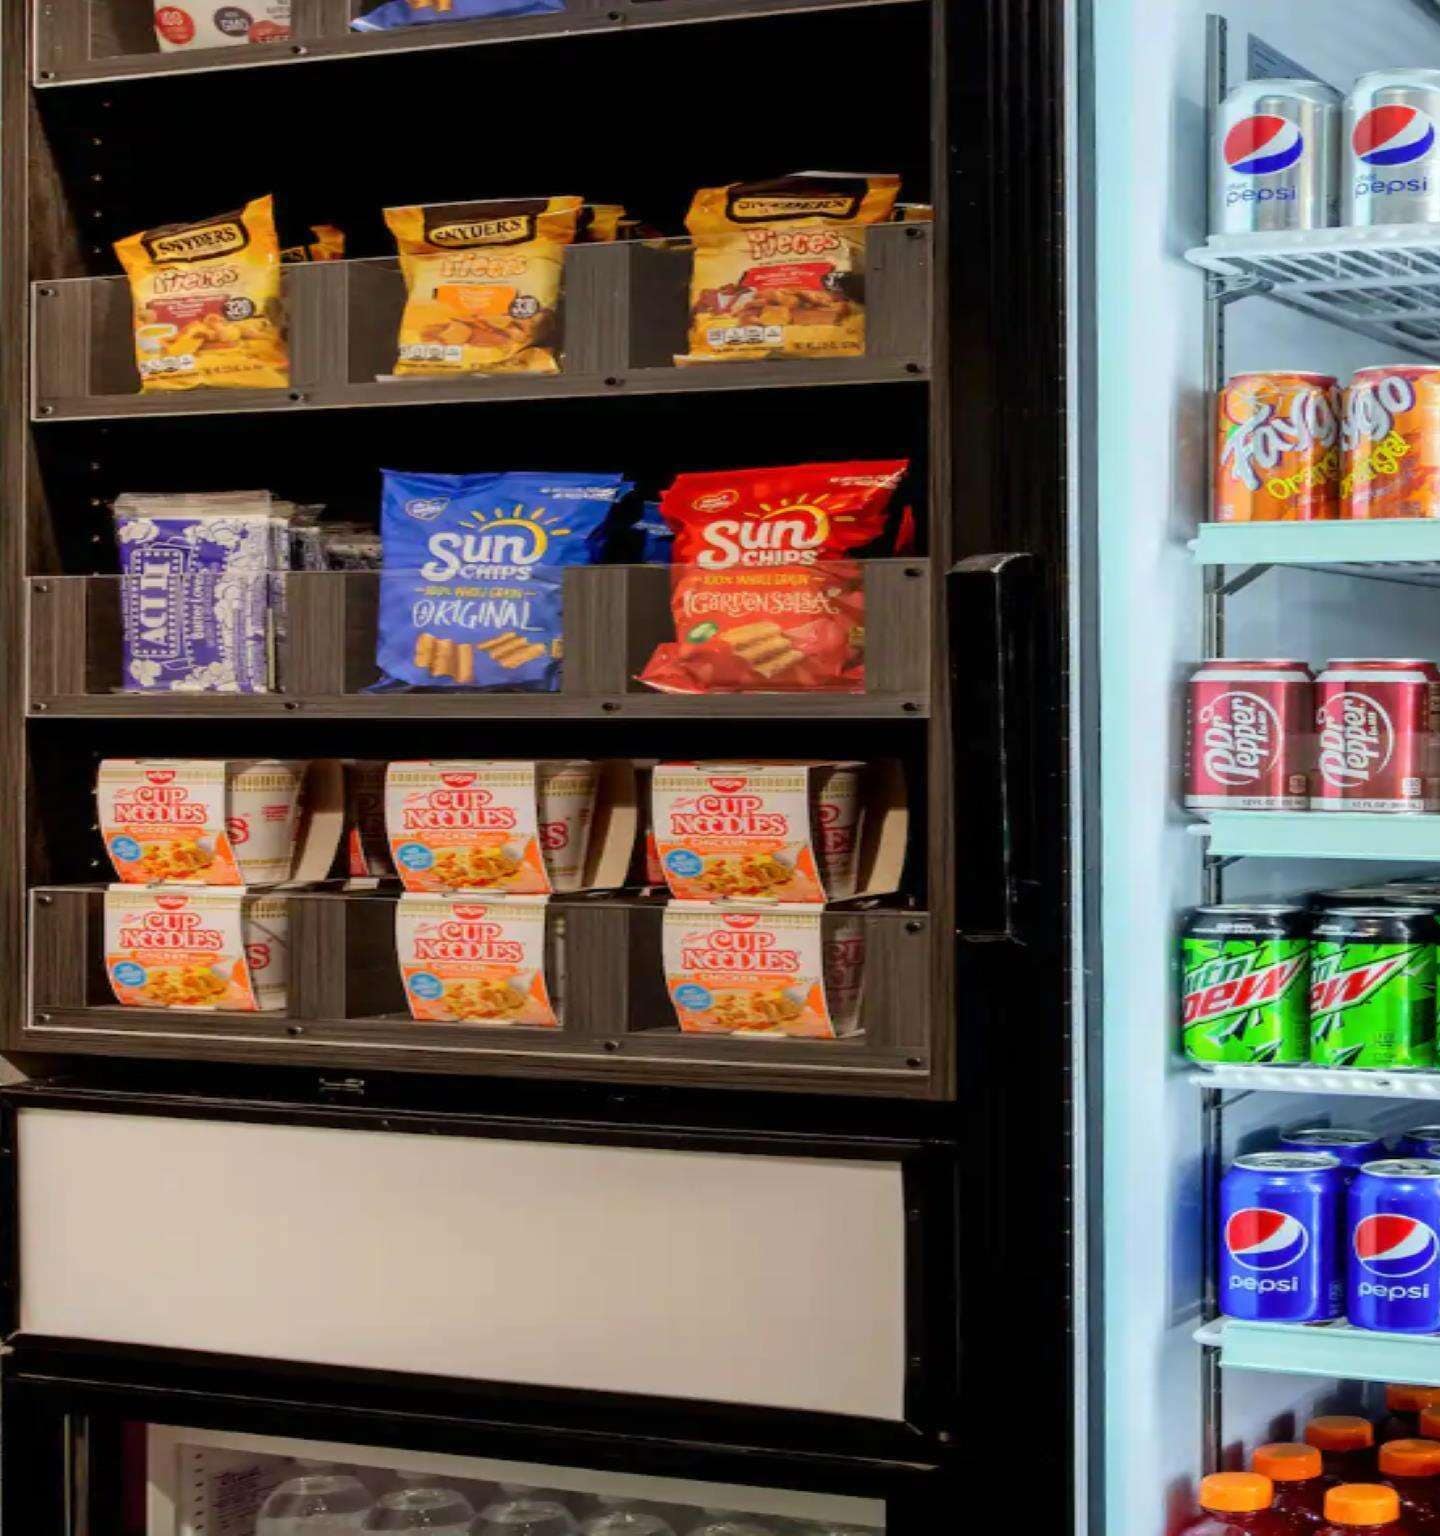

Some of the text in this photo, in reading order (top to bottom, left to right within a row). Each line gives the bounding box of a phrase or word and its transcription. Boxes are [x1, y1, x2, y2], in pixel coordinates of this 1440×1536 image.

[1226, 184, 1295, 206] pepsi
[1355, 176, 1427, 201] pepsi
[696, 517, 826, 570] Sun
[421, 530, 545, 581] Sun
[741, 549, 817, 567] CHIPS
[459, 564, 534, 581] CHIPS
[140, 597, 169, 646] ACT
[413, 600, 545, 631] ORIGINAL
[1204, 695, 1270, 786] Dr Pepper
[1319, 699, 1380, 788] Dr Pepper
[133, 786, 188, 805] CUP
[429, 789, 493, 810] CUP
[696, 794, 763, 816] CUP
[114, 803, 208, 825] NOODLES
[404, 807, 517, 830] NOODLES
[670, 813, 790, 837] NOODLES
[143, 912, 202, 931] CUP
[439, 921, 503, 942] CUP
[119, 928, 224, 950] NOODLES
[707, 929, 777, 951] CUP
[414, 938, 524, 963] NOODLES
[681, 948, 801, 973] NOODLES
[1229, 1273, 1299, 1295] pepsi
[1358, 1281, 1430, 1302] pepsi
